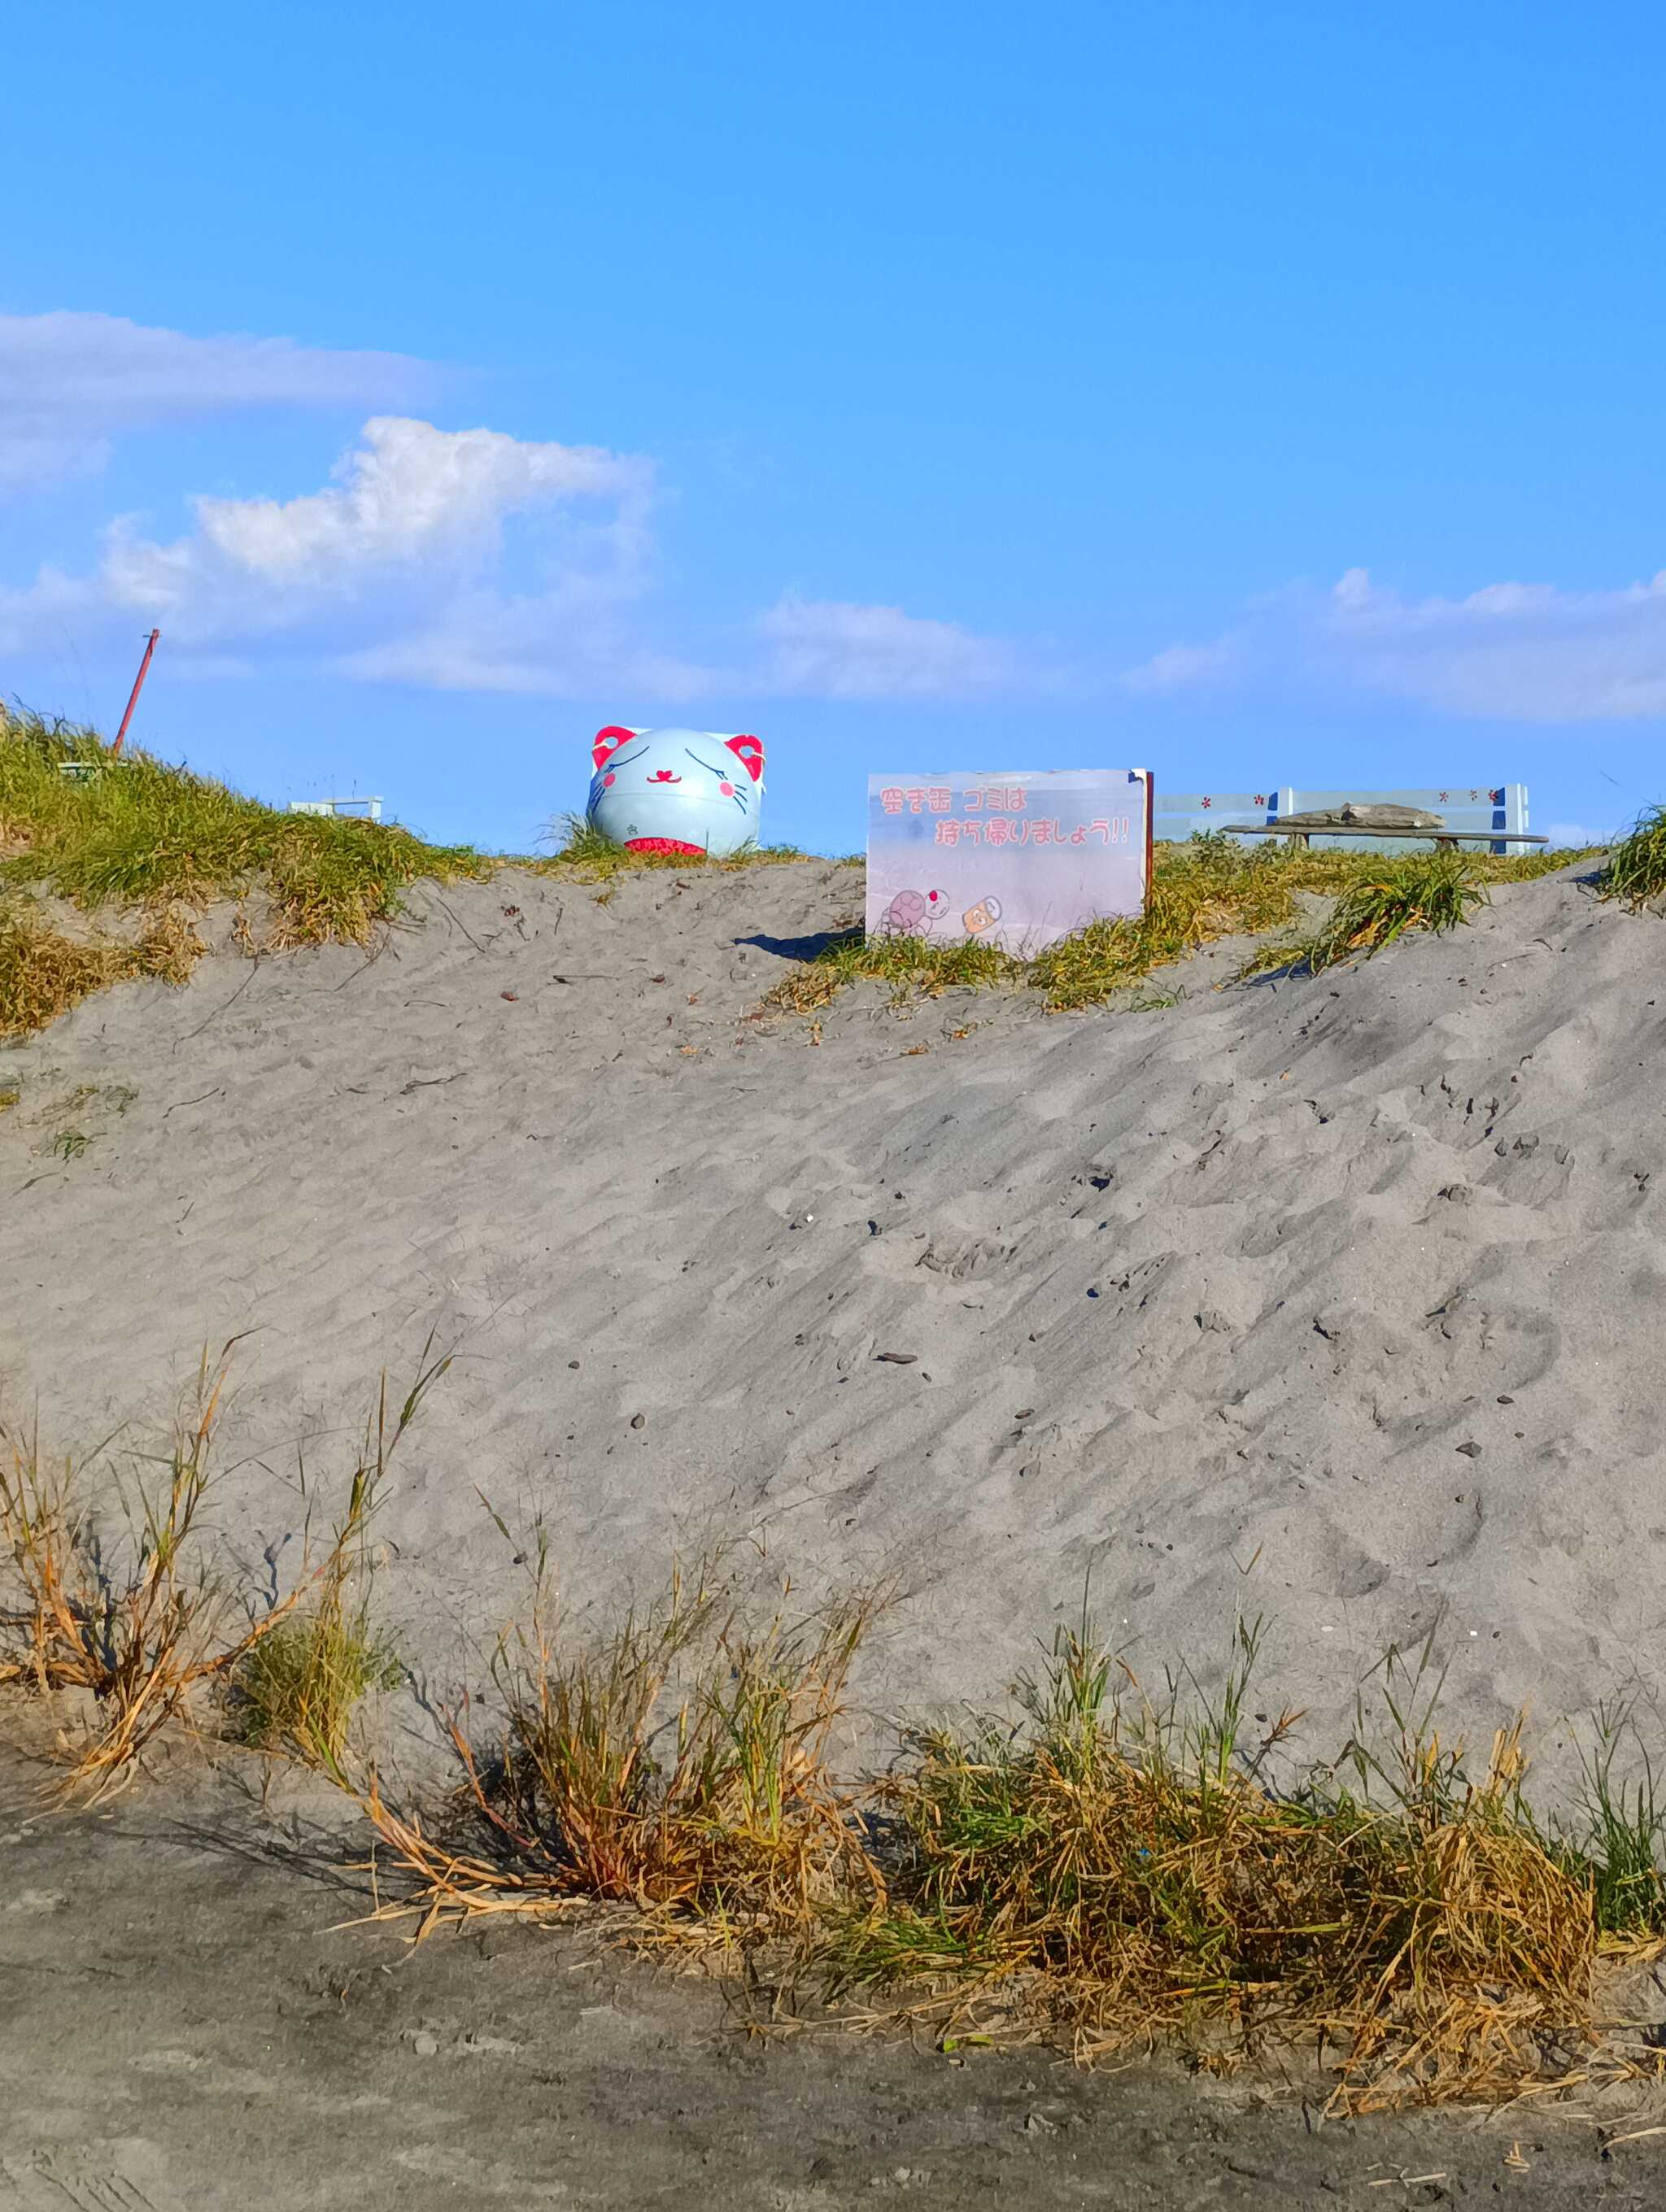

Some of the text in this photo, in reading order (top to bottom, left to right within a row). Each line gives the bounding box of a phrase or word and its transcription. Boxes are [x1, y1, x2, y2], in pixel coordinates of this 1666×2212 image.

[881, 787, 1027, 813] 空き缶 ゴミは
